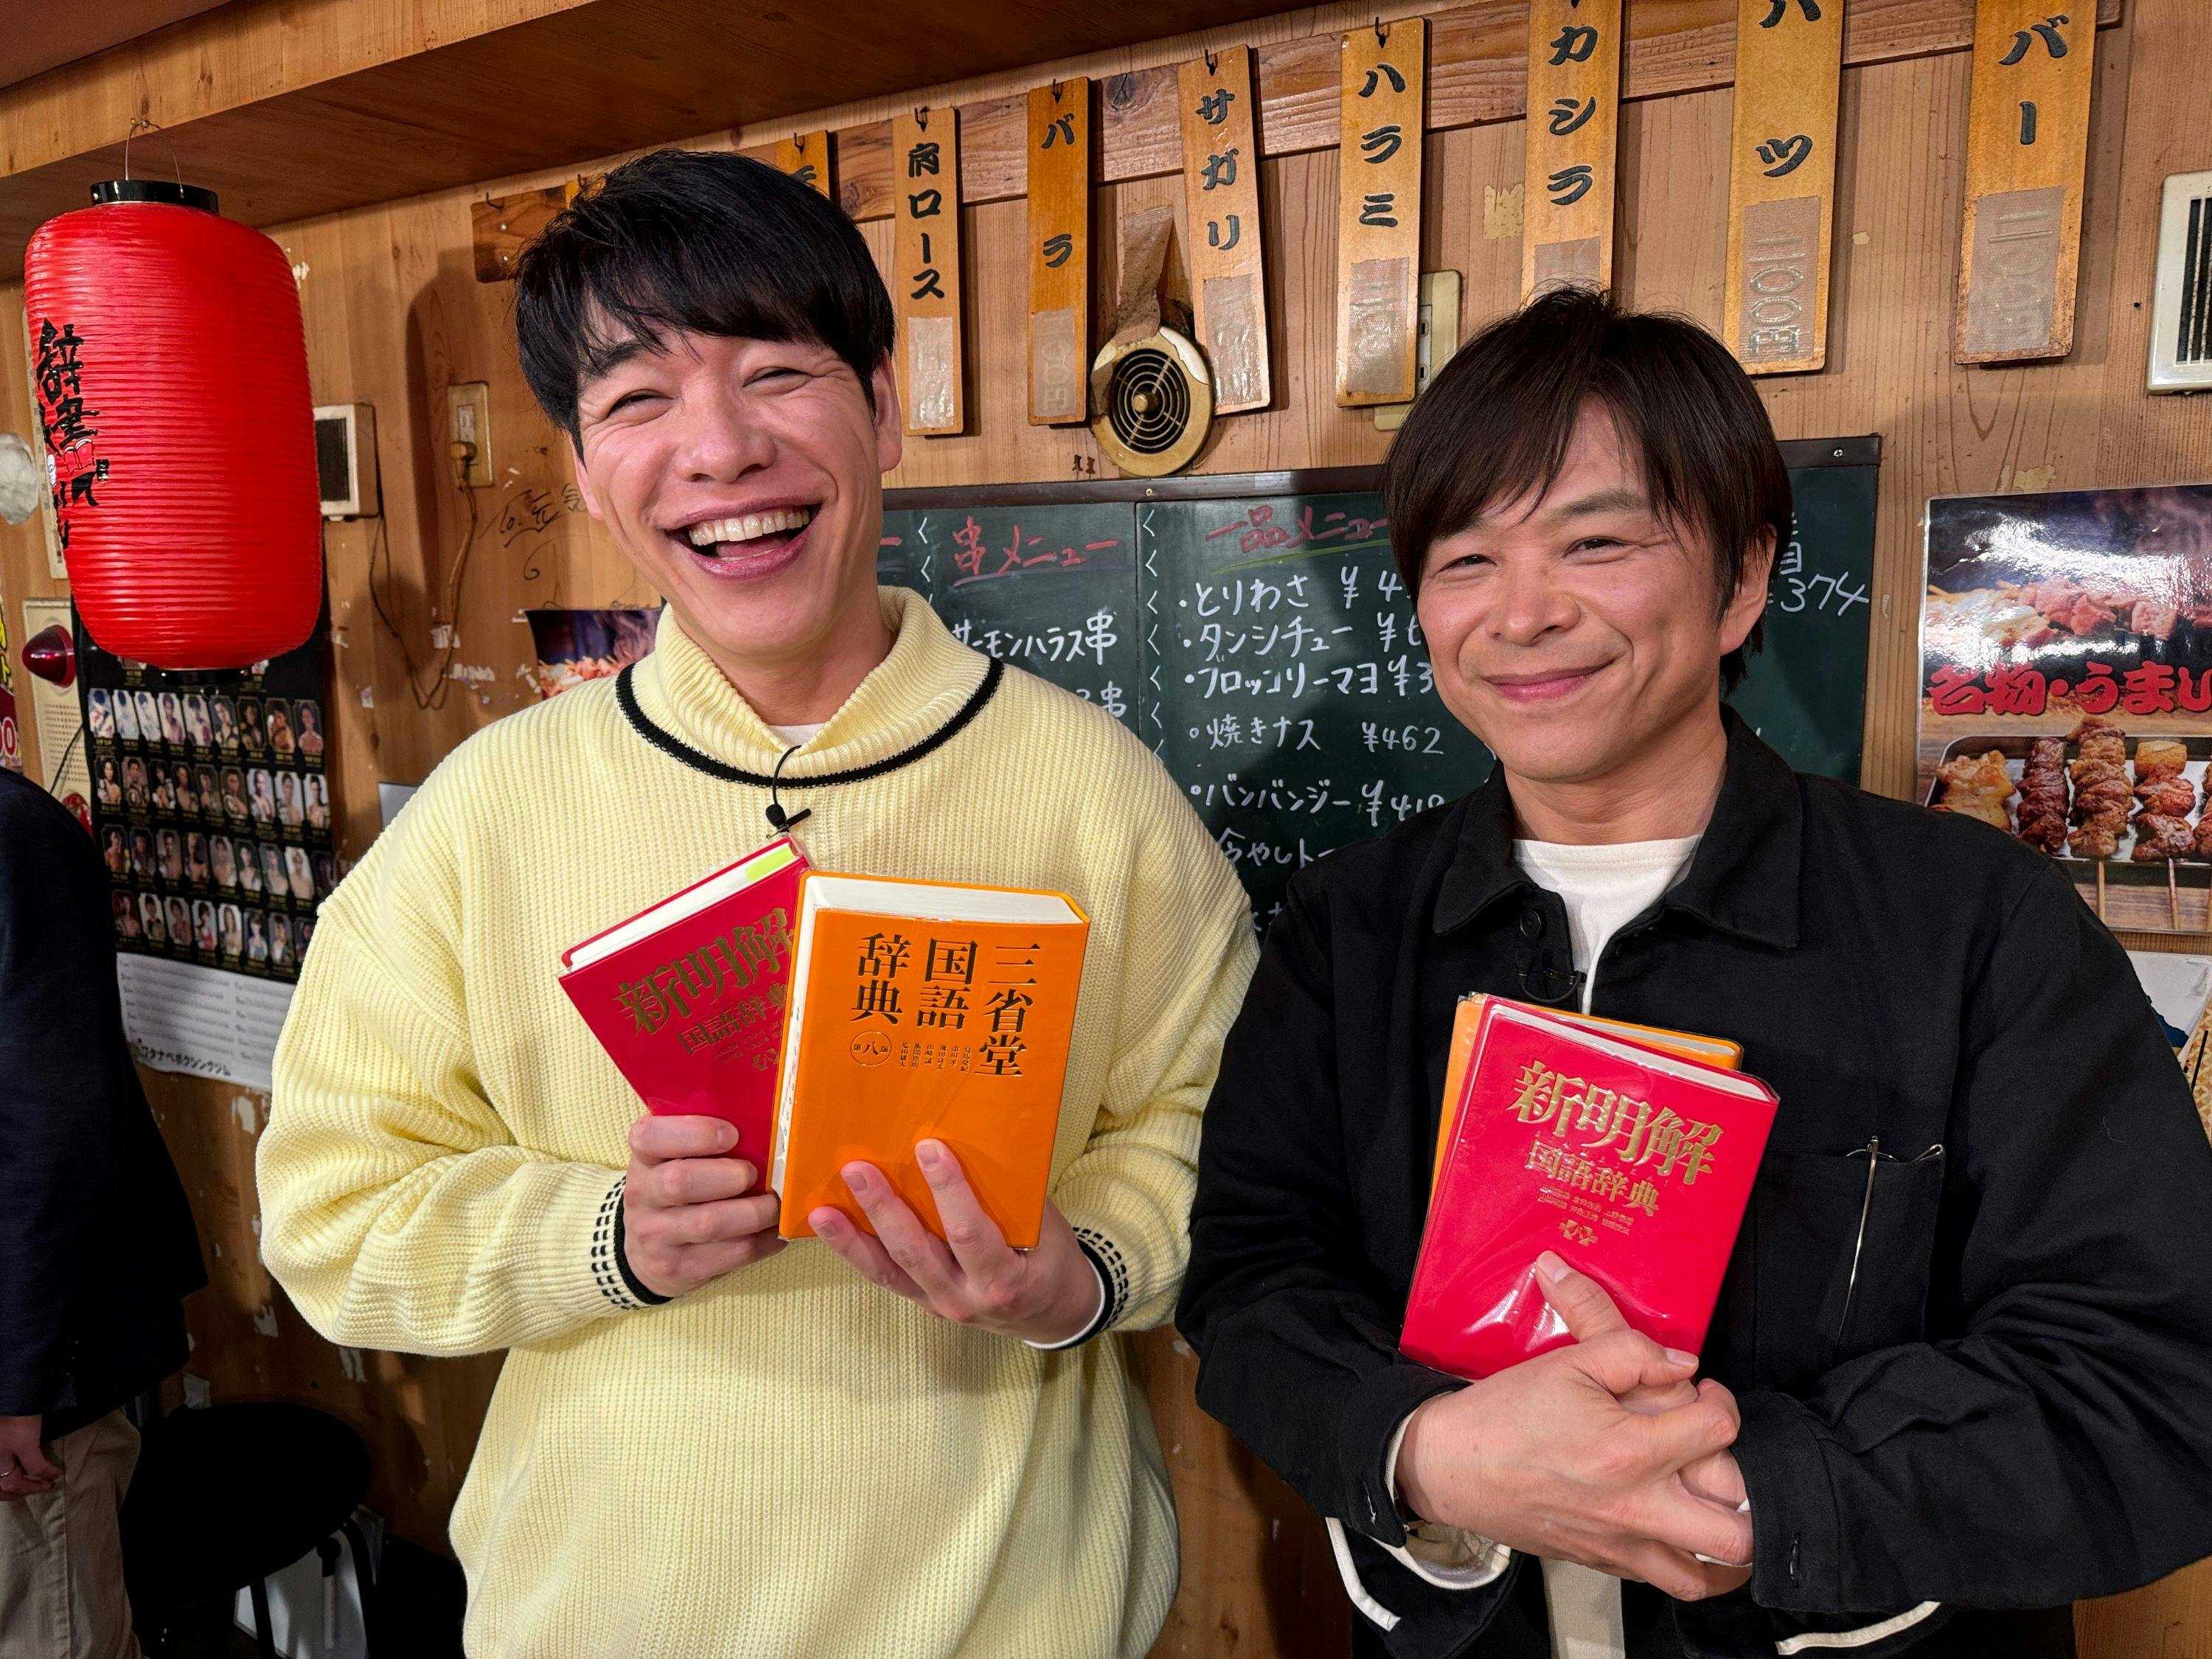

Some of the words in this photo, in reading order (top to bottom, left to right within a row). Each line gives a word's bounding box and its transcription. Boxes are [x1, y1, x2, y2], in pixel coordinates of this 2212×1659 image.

[1358, 63, 1407, 228] ハラミ
[1546, 26, 1599, 206] カシラ
[1040, 112, 1077, 269] バラ
[1195, 88, 1240, 251] サガリ
[908, 142, 945, 300] 肩ロース
[953, 516, 1121, 575] 串メニュー
[953, 613, 1117, 665] サーモンハラス串
[1195, 575, 1310, 616] とりわさ
[1200, 616, 1352, 658] タンシチュー
[1197, 657, 1378, 699] ブロッコリーマヨ
[1206, 713, 1321, 751] 焼きナス
[1362, 720, 1444, 755] ¥462
[1206, 773, 1352, 814] バンバンジー
[614, 908, 794, 1036] 新明解
[849, 933, 911, 1025] 辞典
[917, 938, 978, 1029] 国語
[974, 943, 1041, 1076] 三省堂
[1506, 1060, 1723, 1185] 新明解
[1524, 1138, 1659, 1217] 国語辞典
